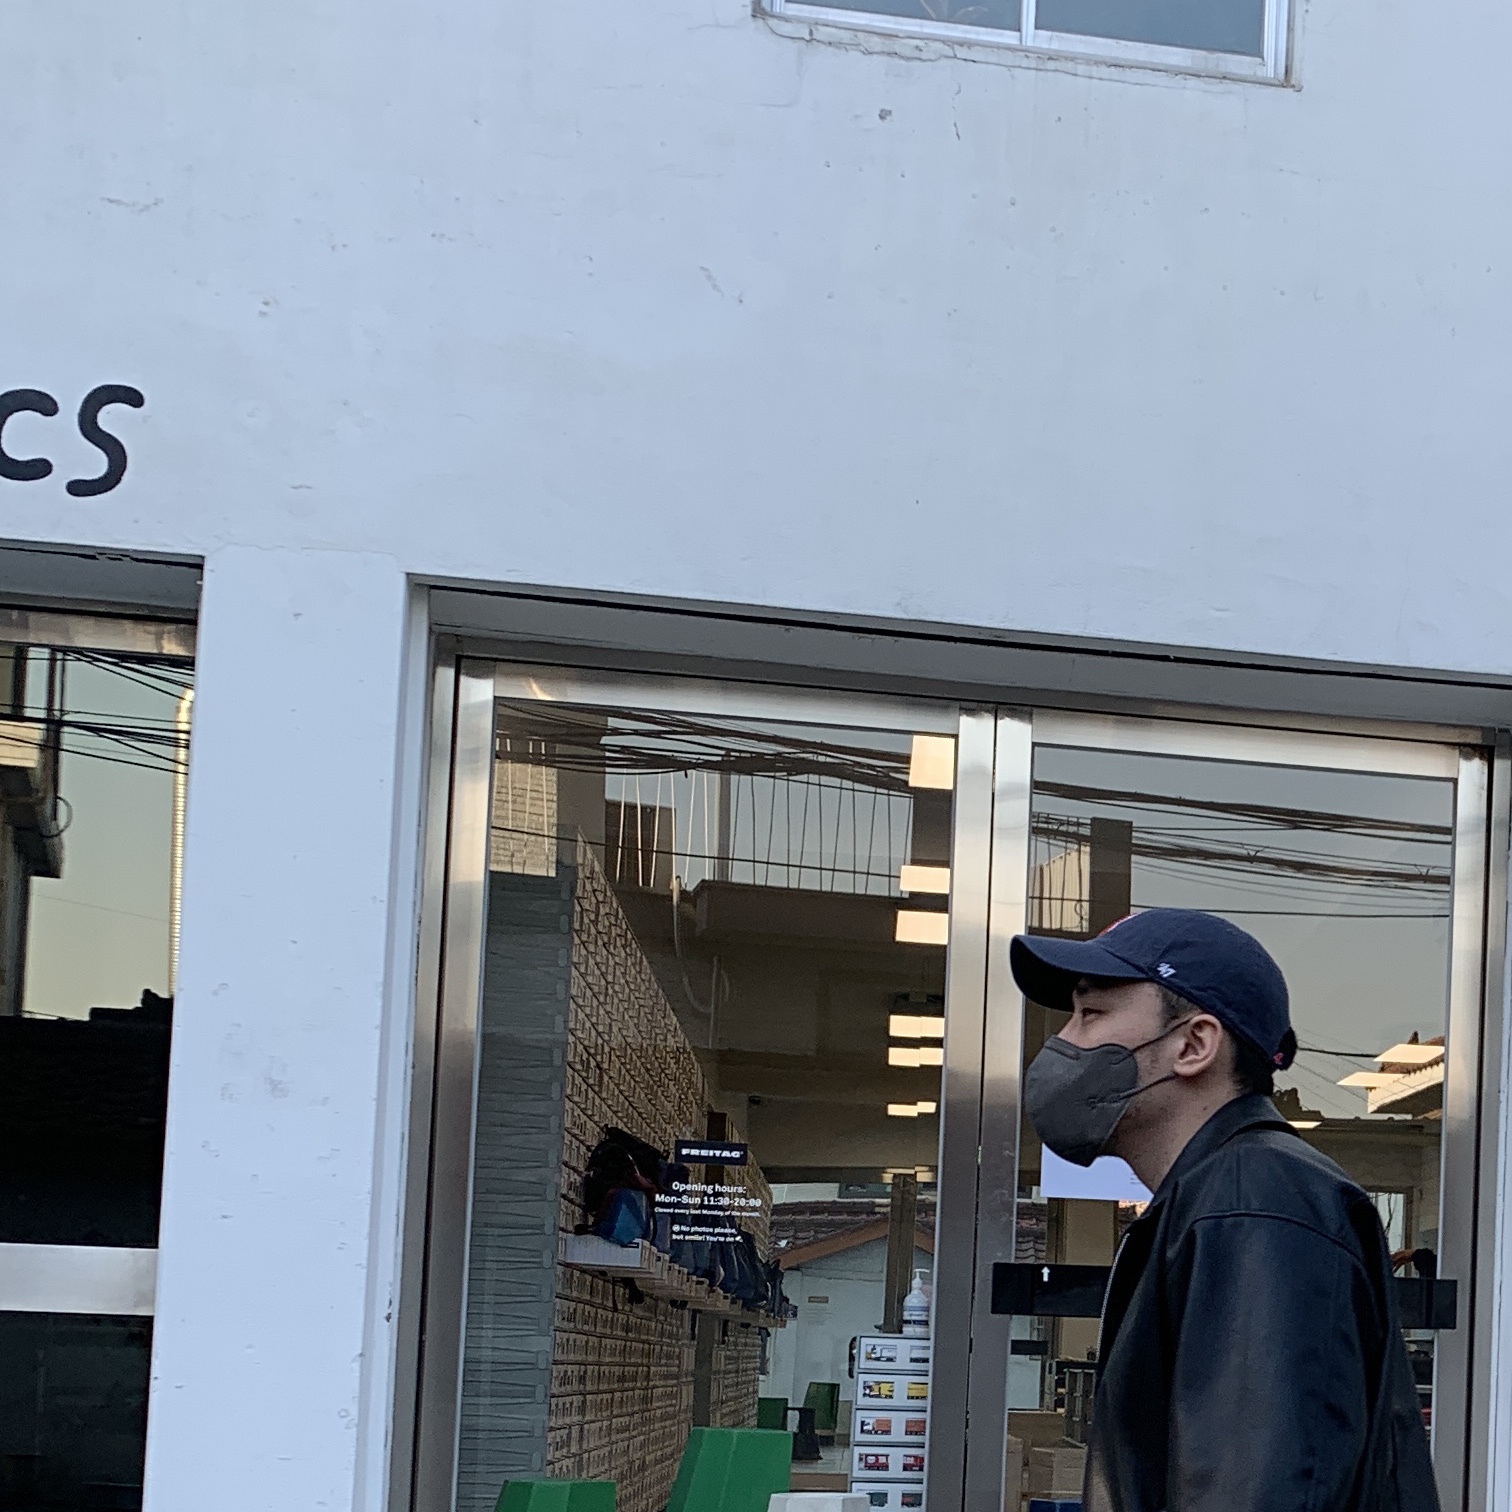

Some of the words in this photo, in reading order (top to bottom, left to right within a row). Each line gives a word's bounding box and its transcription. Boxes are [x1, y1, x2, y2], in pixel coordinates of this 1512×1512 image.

[681, 1147, 742, 1159] FREITAG
[672, 1181, 714, 1194] Opening
[715, 1183, 747, 1194] hours:
[655, 1193, 701, 1205] Mon-Sun
[703, 1196, 762, 1207] 11:30-20:00
